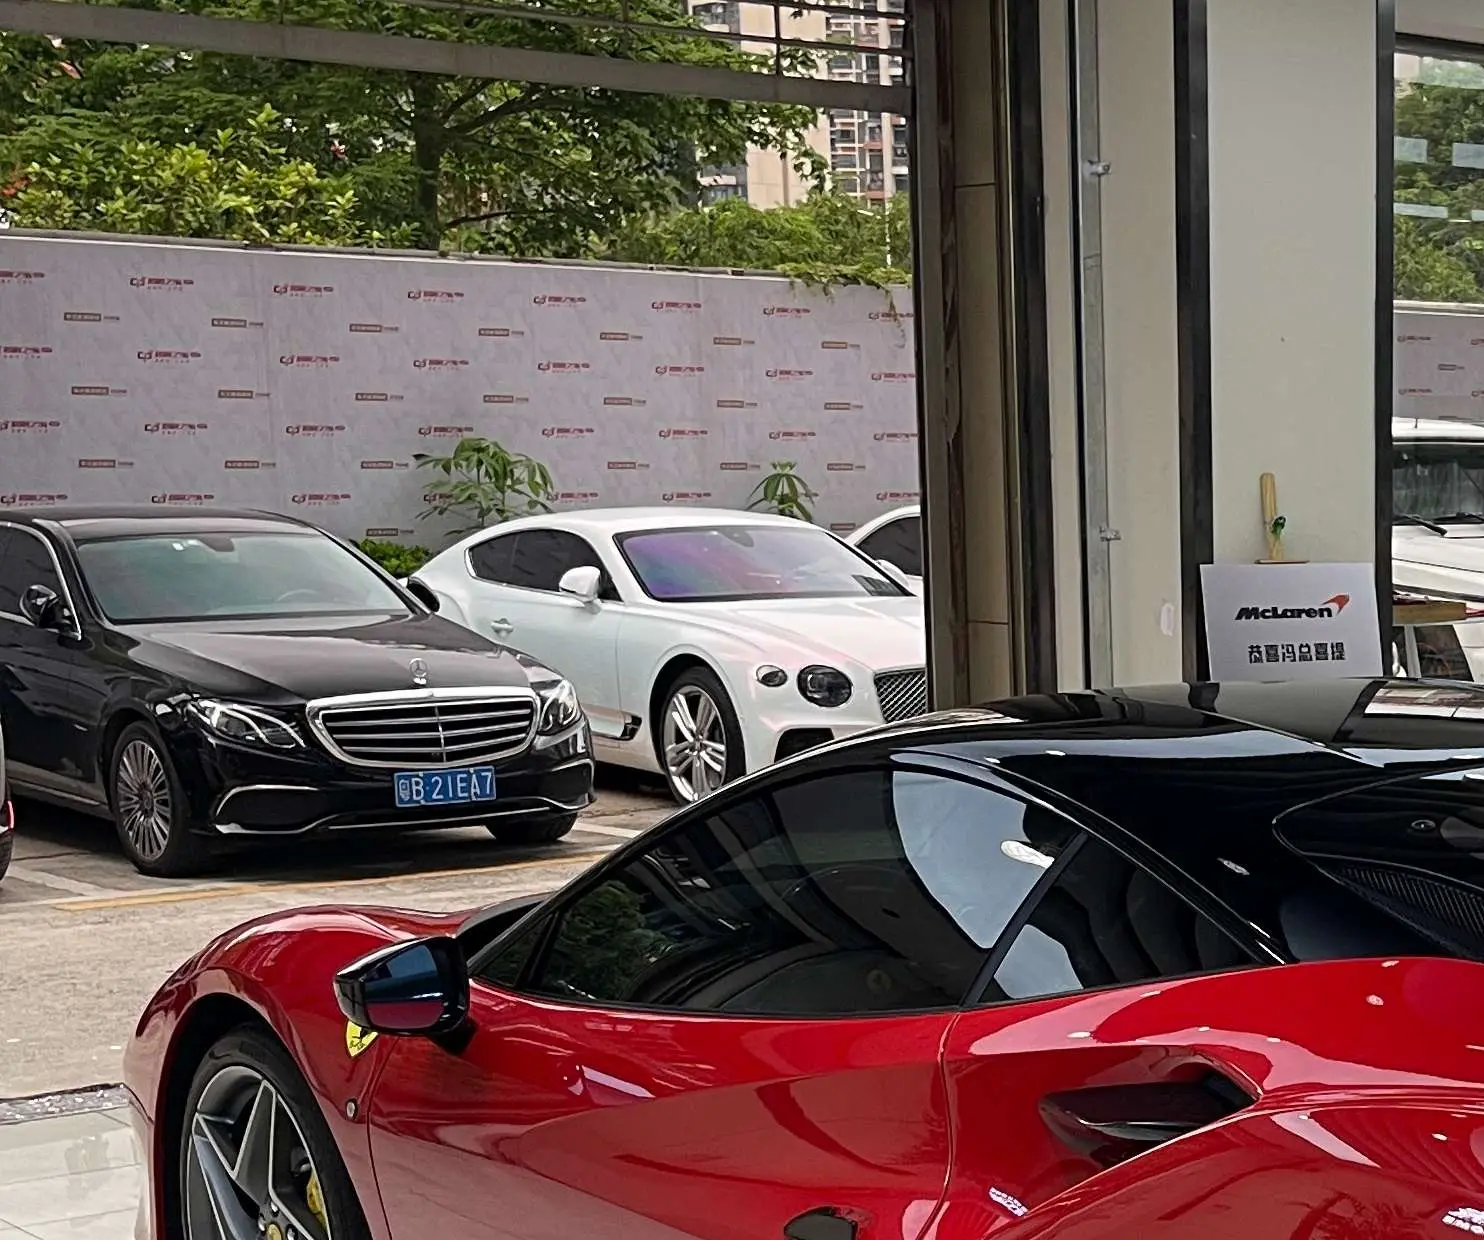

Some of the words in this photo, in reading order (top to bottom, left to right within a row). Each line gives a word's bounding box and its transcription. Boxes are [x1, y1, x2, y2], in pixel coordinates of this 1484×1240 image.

[1235, 606, 1333, 621] McLaren
[1248, 641, 1346, 664] 恭喜冯总喜提
